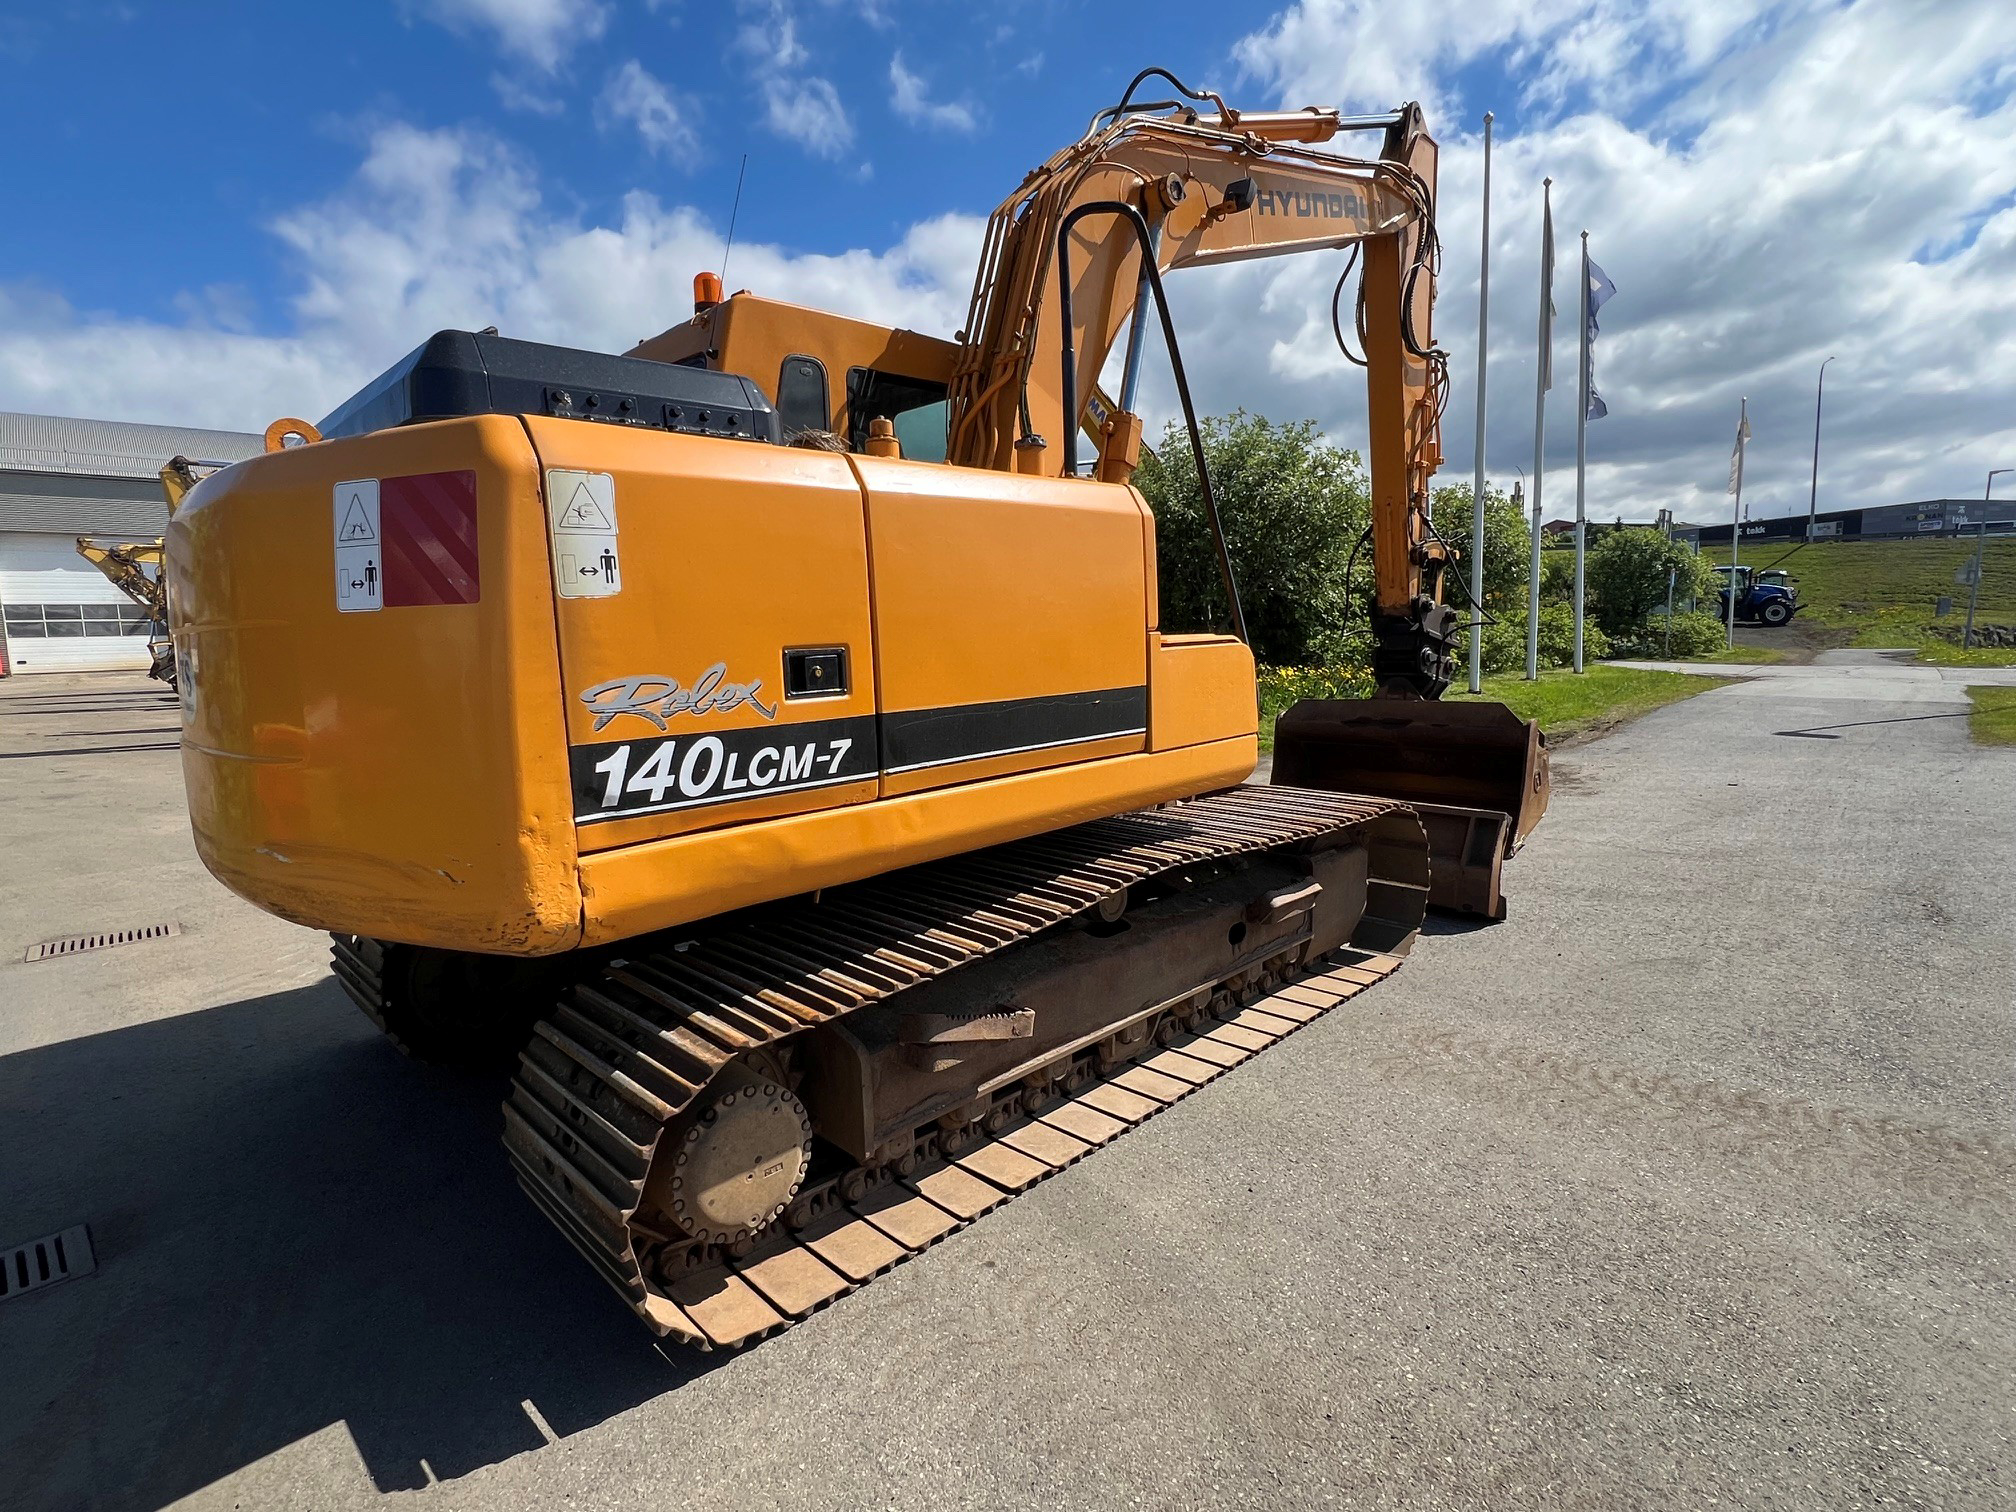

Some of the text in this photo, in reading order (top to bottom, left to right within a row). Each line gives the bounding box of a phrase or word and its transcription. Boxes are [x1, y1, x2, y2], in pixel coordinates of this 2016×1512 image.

[1257, 189, 1366, 219] HYUNDAI
[1918, 503, 1940, 511] ELKO
[579, 661, 778, 732] Robex
